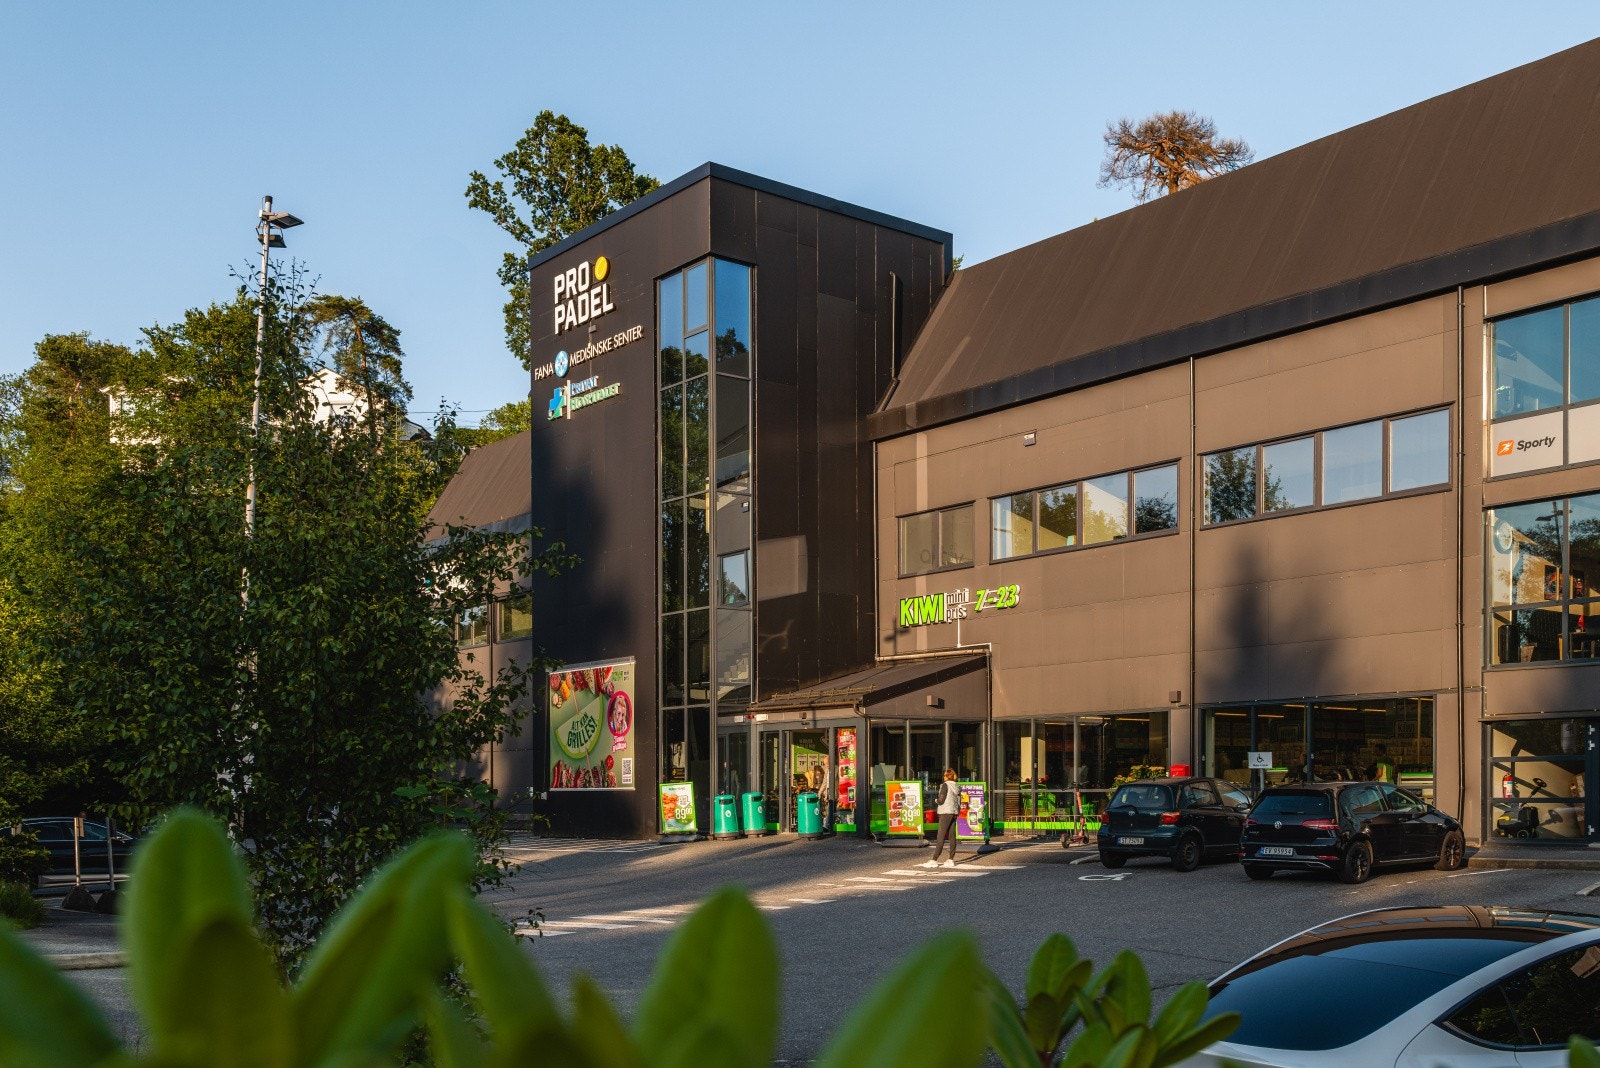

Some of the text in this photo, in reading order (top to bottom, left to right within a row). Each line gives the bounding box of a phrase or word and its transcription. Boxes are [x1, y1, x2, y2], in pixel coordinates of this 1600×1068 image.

[554, 261, 590, 304] PRO
[554, 283, 615, 335] PADEL
[534, 325, 644, 380] FANA MEDISINSKE SENTER
[1516, 436, 1556, 452] Sporty
[900, 592, 945, 627] KIWI
[946, 588, 969, 605] mini
[946, 607, 967, 624] pris
